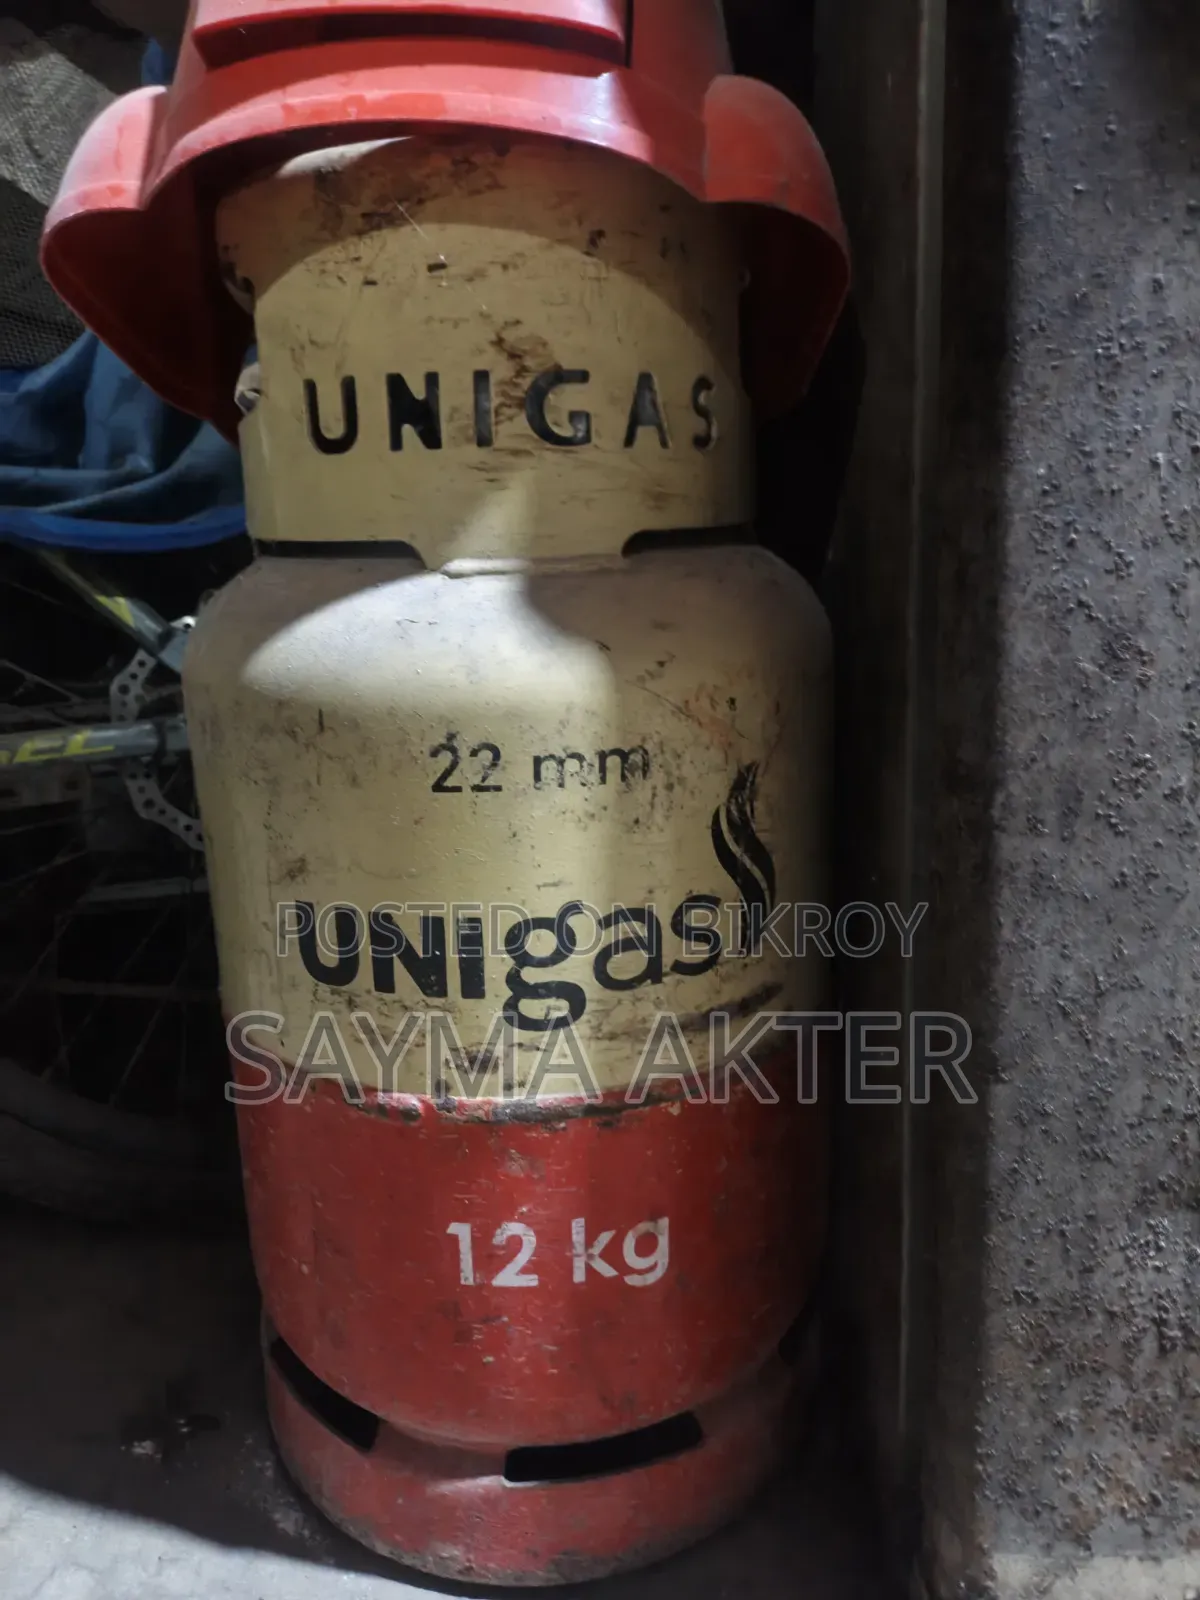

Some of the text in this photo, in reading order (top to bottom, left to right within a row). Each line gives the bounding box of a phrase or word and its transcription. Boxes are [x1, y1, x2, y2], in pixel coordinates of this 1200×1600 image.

[303, 367, 720, 456] UNIGAS
[430, 740, 651, 794] 22 mm
[446, 1216, 670, 1288] 12 kg
